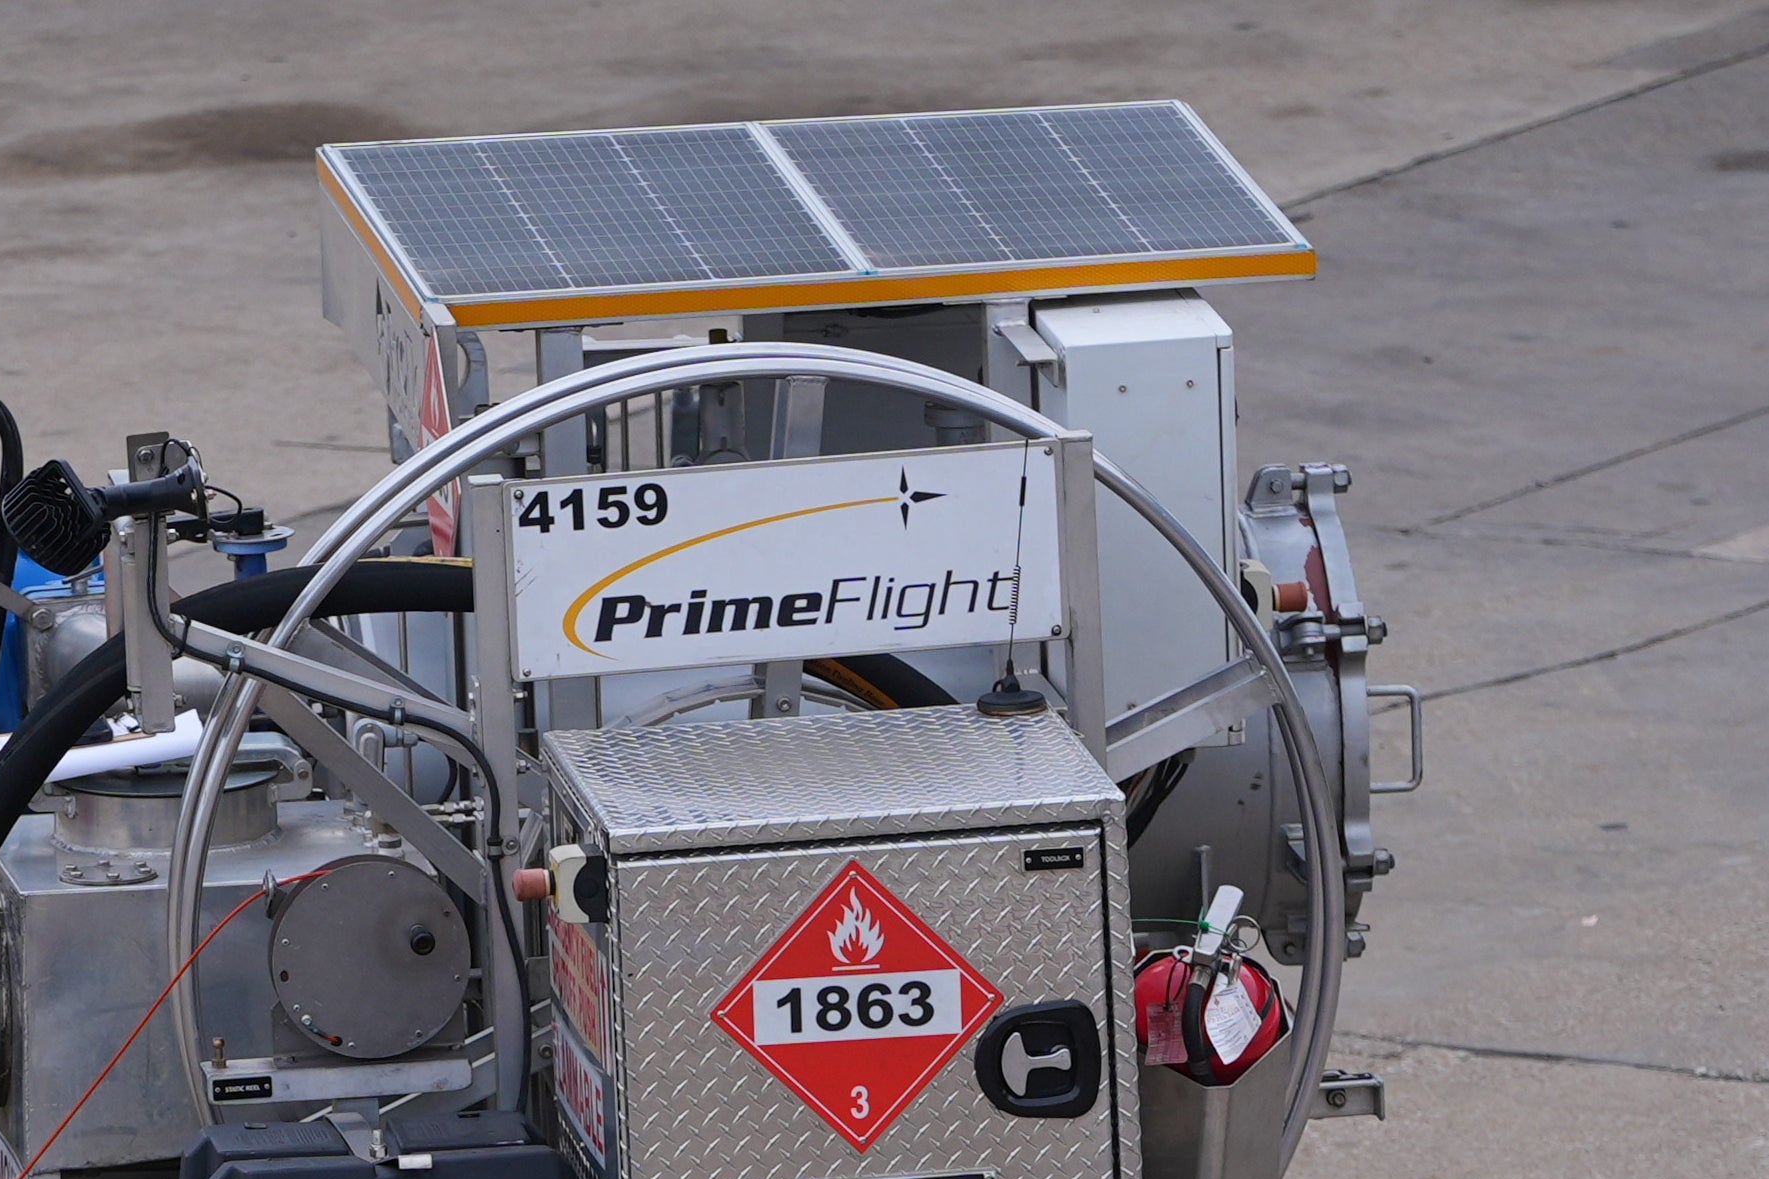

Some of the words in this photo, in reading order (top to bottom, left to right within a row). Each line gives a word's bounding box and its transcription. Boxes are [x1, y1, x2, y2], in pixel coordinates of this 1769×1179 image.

[519, 483, 669, 533] 4159
[593, 569, 1015, 643] PrimeFlight
[776, 980, 935, 1034] 1863
[849, 1085, 871, 1120] 3
